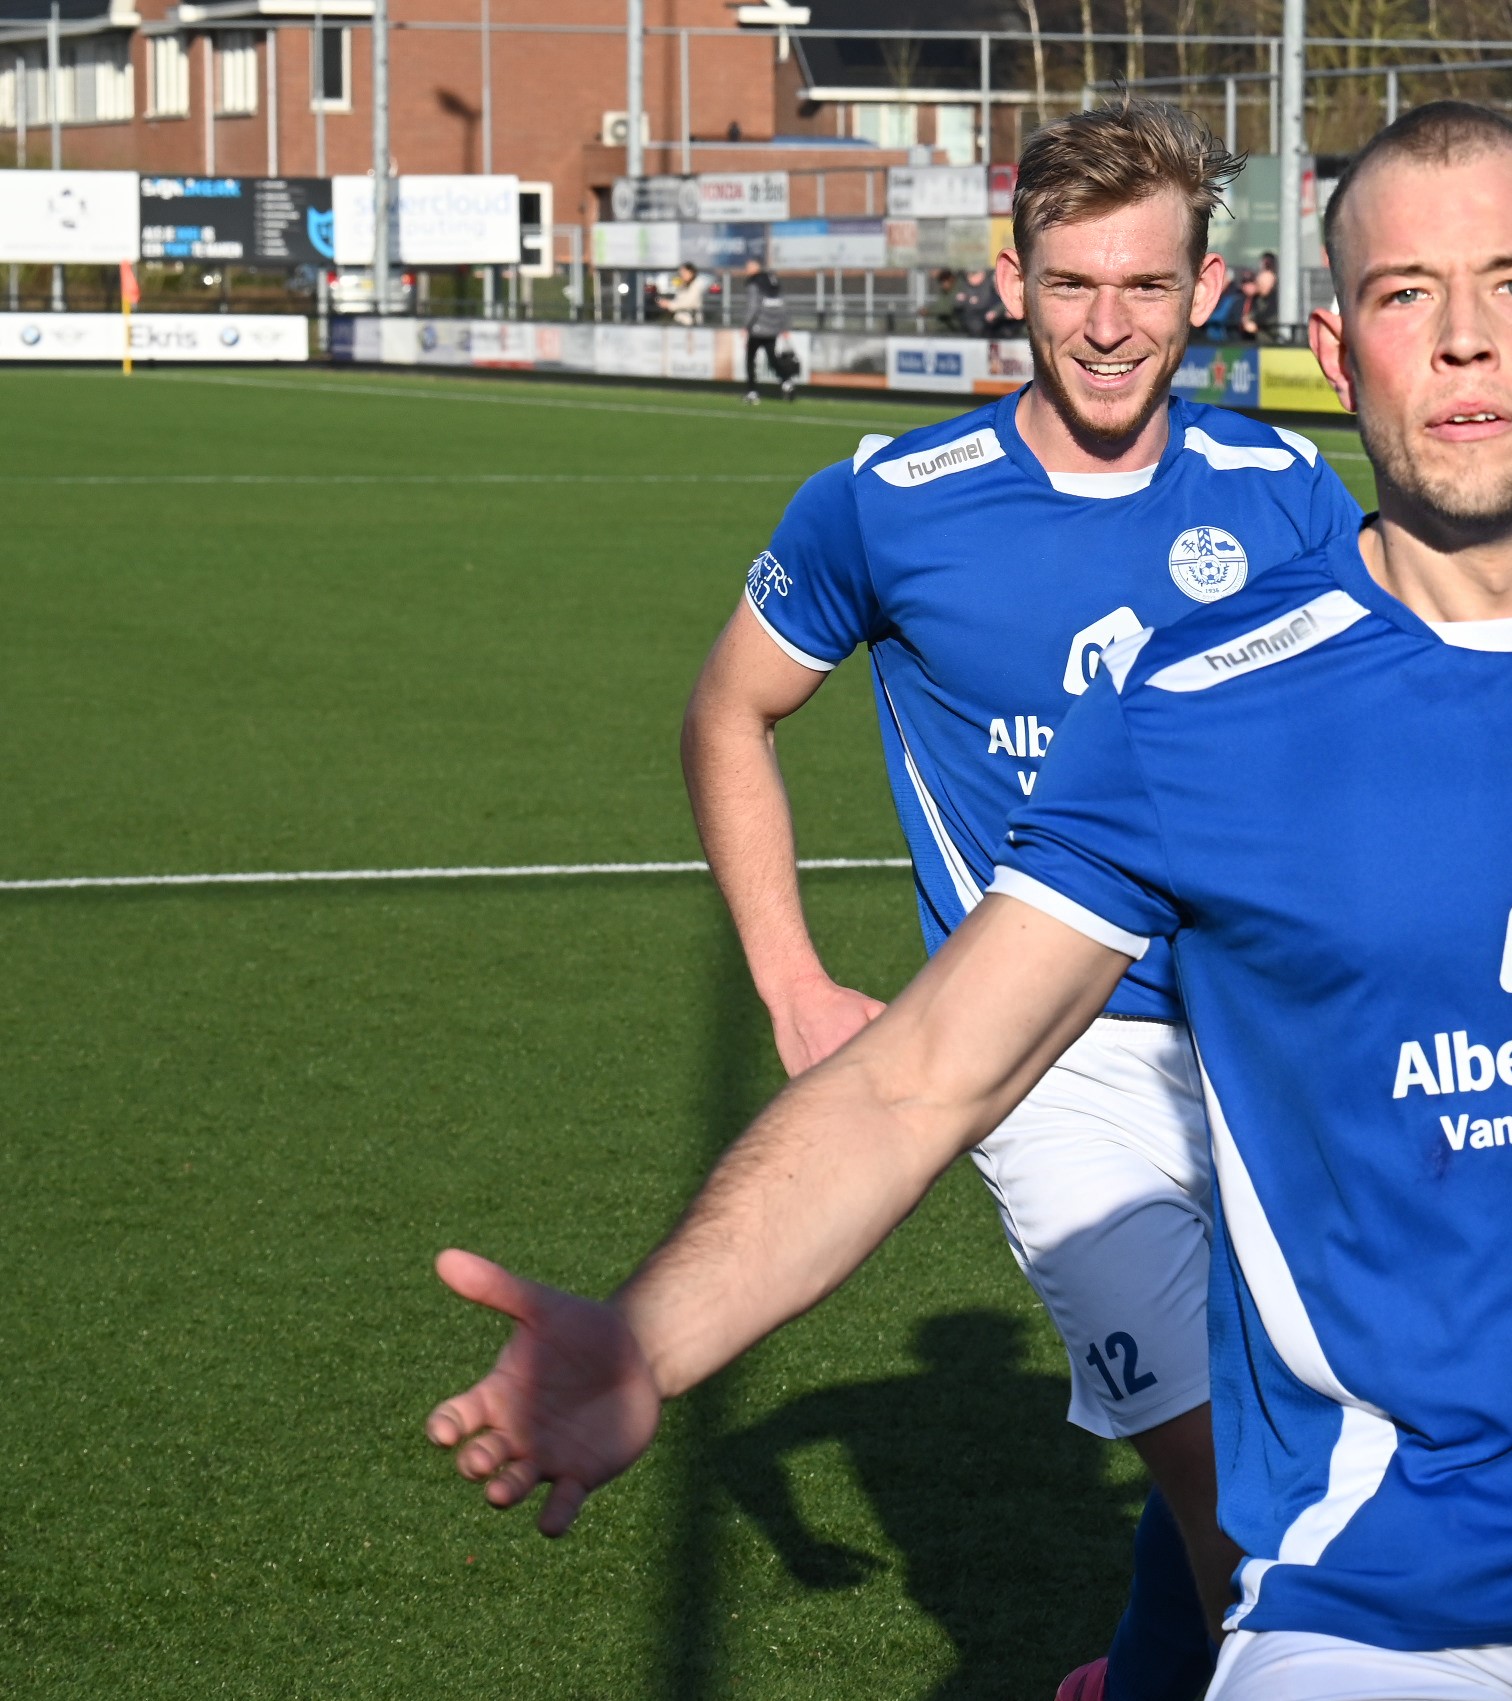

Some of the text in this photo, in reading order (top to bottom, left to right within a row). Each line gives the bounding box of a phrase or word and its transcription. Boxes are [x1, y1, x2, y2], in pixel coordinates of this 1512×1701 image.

[128, 323, 198, 350] Ekris
[908, 438, 985, 481] hummel
[1204, 609, 1319, 671] hummel
[988, 715, 1055, 758] Alb
[1085, 1331, 1159, 1401] 12
